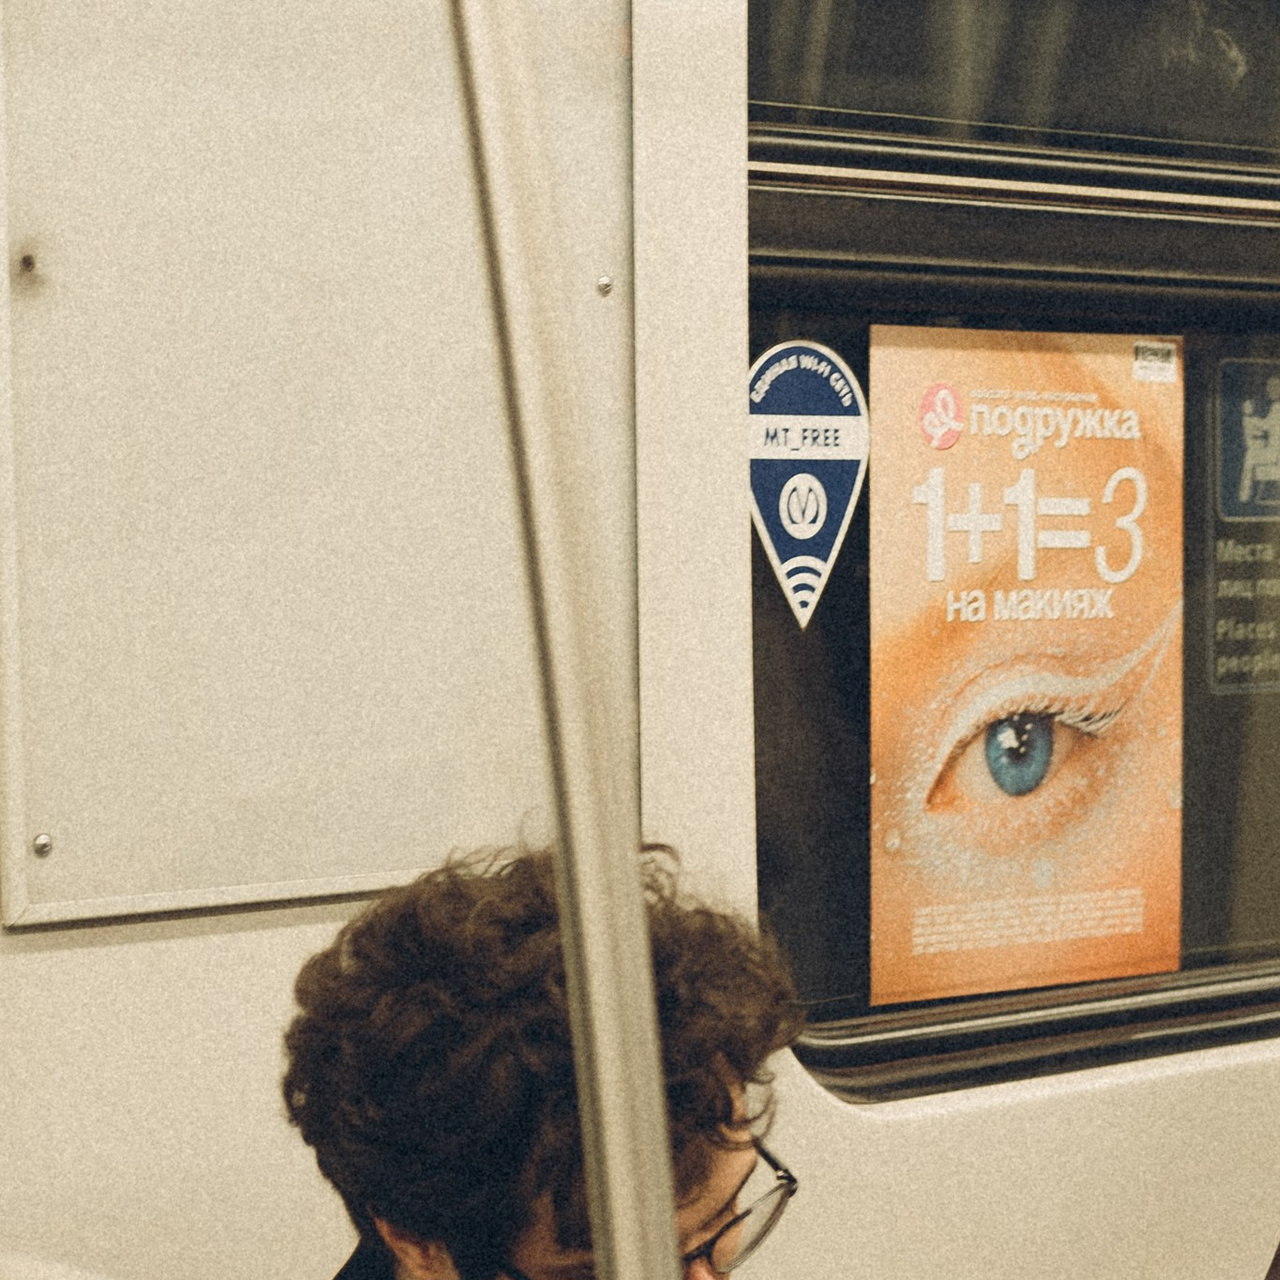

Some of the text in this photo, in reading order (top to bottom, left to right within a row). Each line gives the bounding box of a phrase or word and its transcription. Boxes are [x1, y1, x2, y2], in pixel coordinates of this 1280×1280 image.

[764, 427, 840, 451] MT_FREE
[968, 402, 1142, 460] подружка
[911, 466, 1148, 584] 1+1=3
[1216, 539, 1274, 562] Места
[946, 588, 1114, 622] на макияж
[1216, 618, 1276, 640] Places
